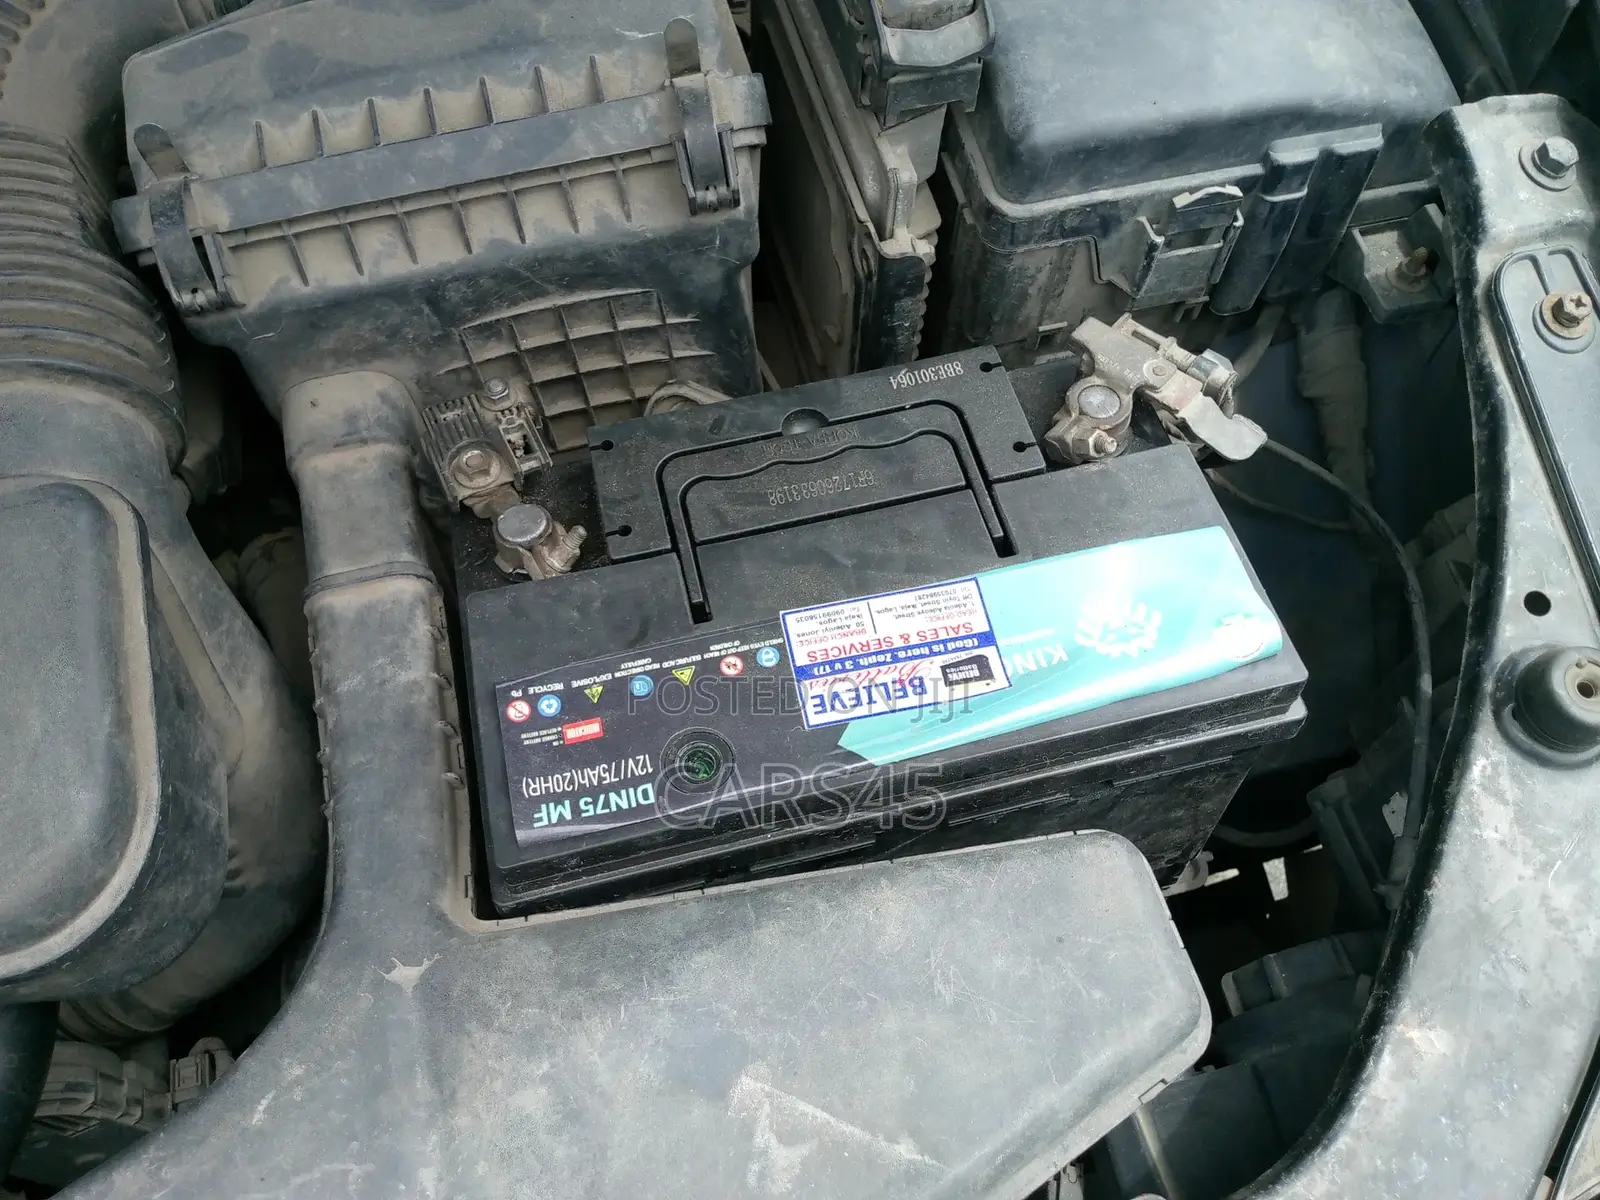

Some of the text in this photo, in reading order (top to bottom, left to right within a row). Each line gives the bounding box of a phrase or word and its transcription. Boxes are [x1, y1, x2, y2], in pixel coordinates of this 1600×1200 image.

[888, 360, 964, 389] 8BE301064
[830, 627, 866, 640] BRANCH
[764, 637, 783, 646] SHIELD
[806, 621, 973, 662] SALES & SERVICES
[931, 643, 944, 653] is
[946, 636, 978, 651] (God
[856, 652, 892, 666] Zeph.
[893, 645, 929, 660] here.
[619, 657, 651, 669] CAREFULLY
[661, 653, 701, 668] SULFURIC ACID
[833, 662, 842, 670] v
[844, 660, 853, 669] 3
[613, 662, 660, 677] READ DIRECTION
[813, 664, 832, 675] 17)
[945, 663, 977, 673] Batteries
[947, 668, 980, 680] BELIEVE
[570, 672, 612, 687] EXPLOSIVE
[510, 688, 522, 697] Pb
[527, 681, 563, 695] RECYCLE
[810, 679, 927, 715] BELIEVE
[530, 782, 655, 827] DIN75 MF
